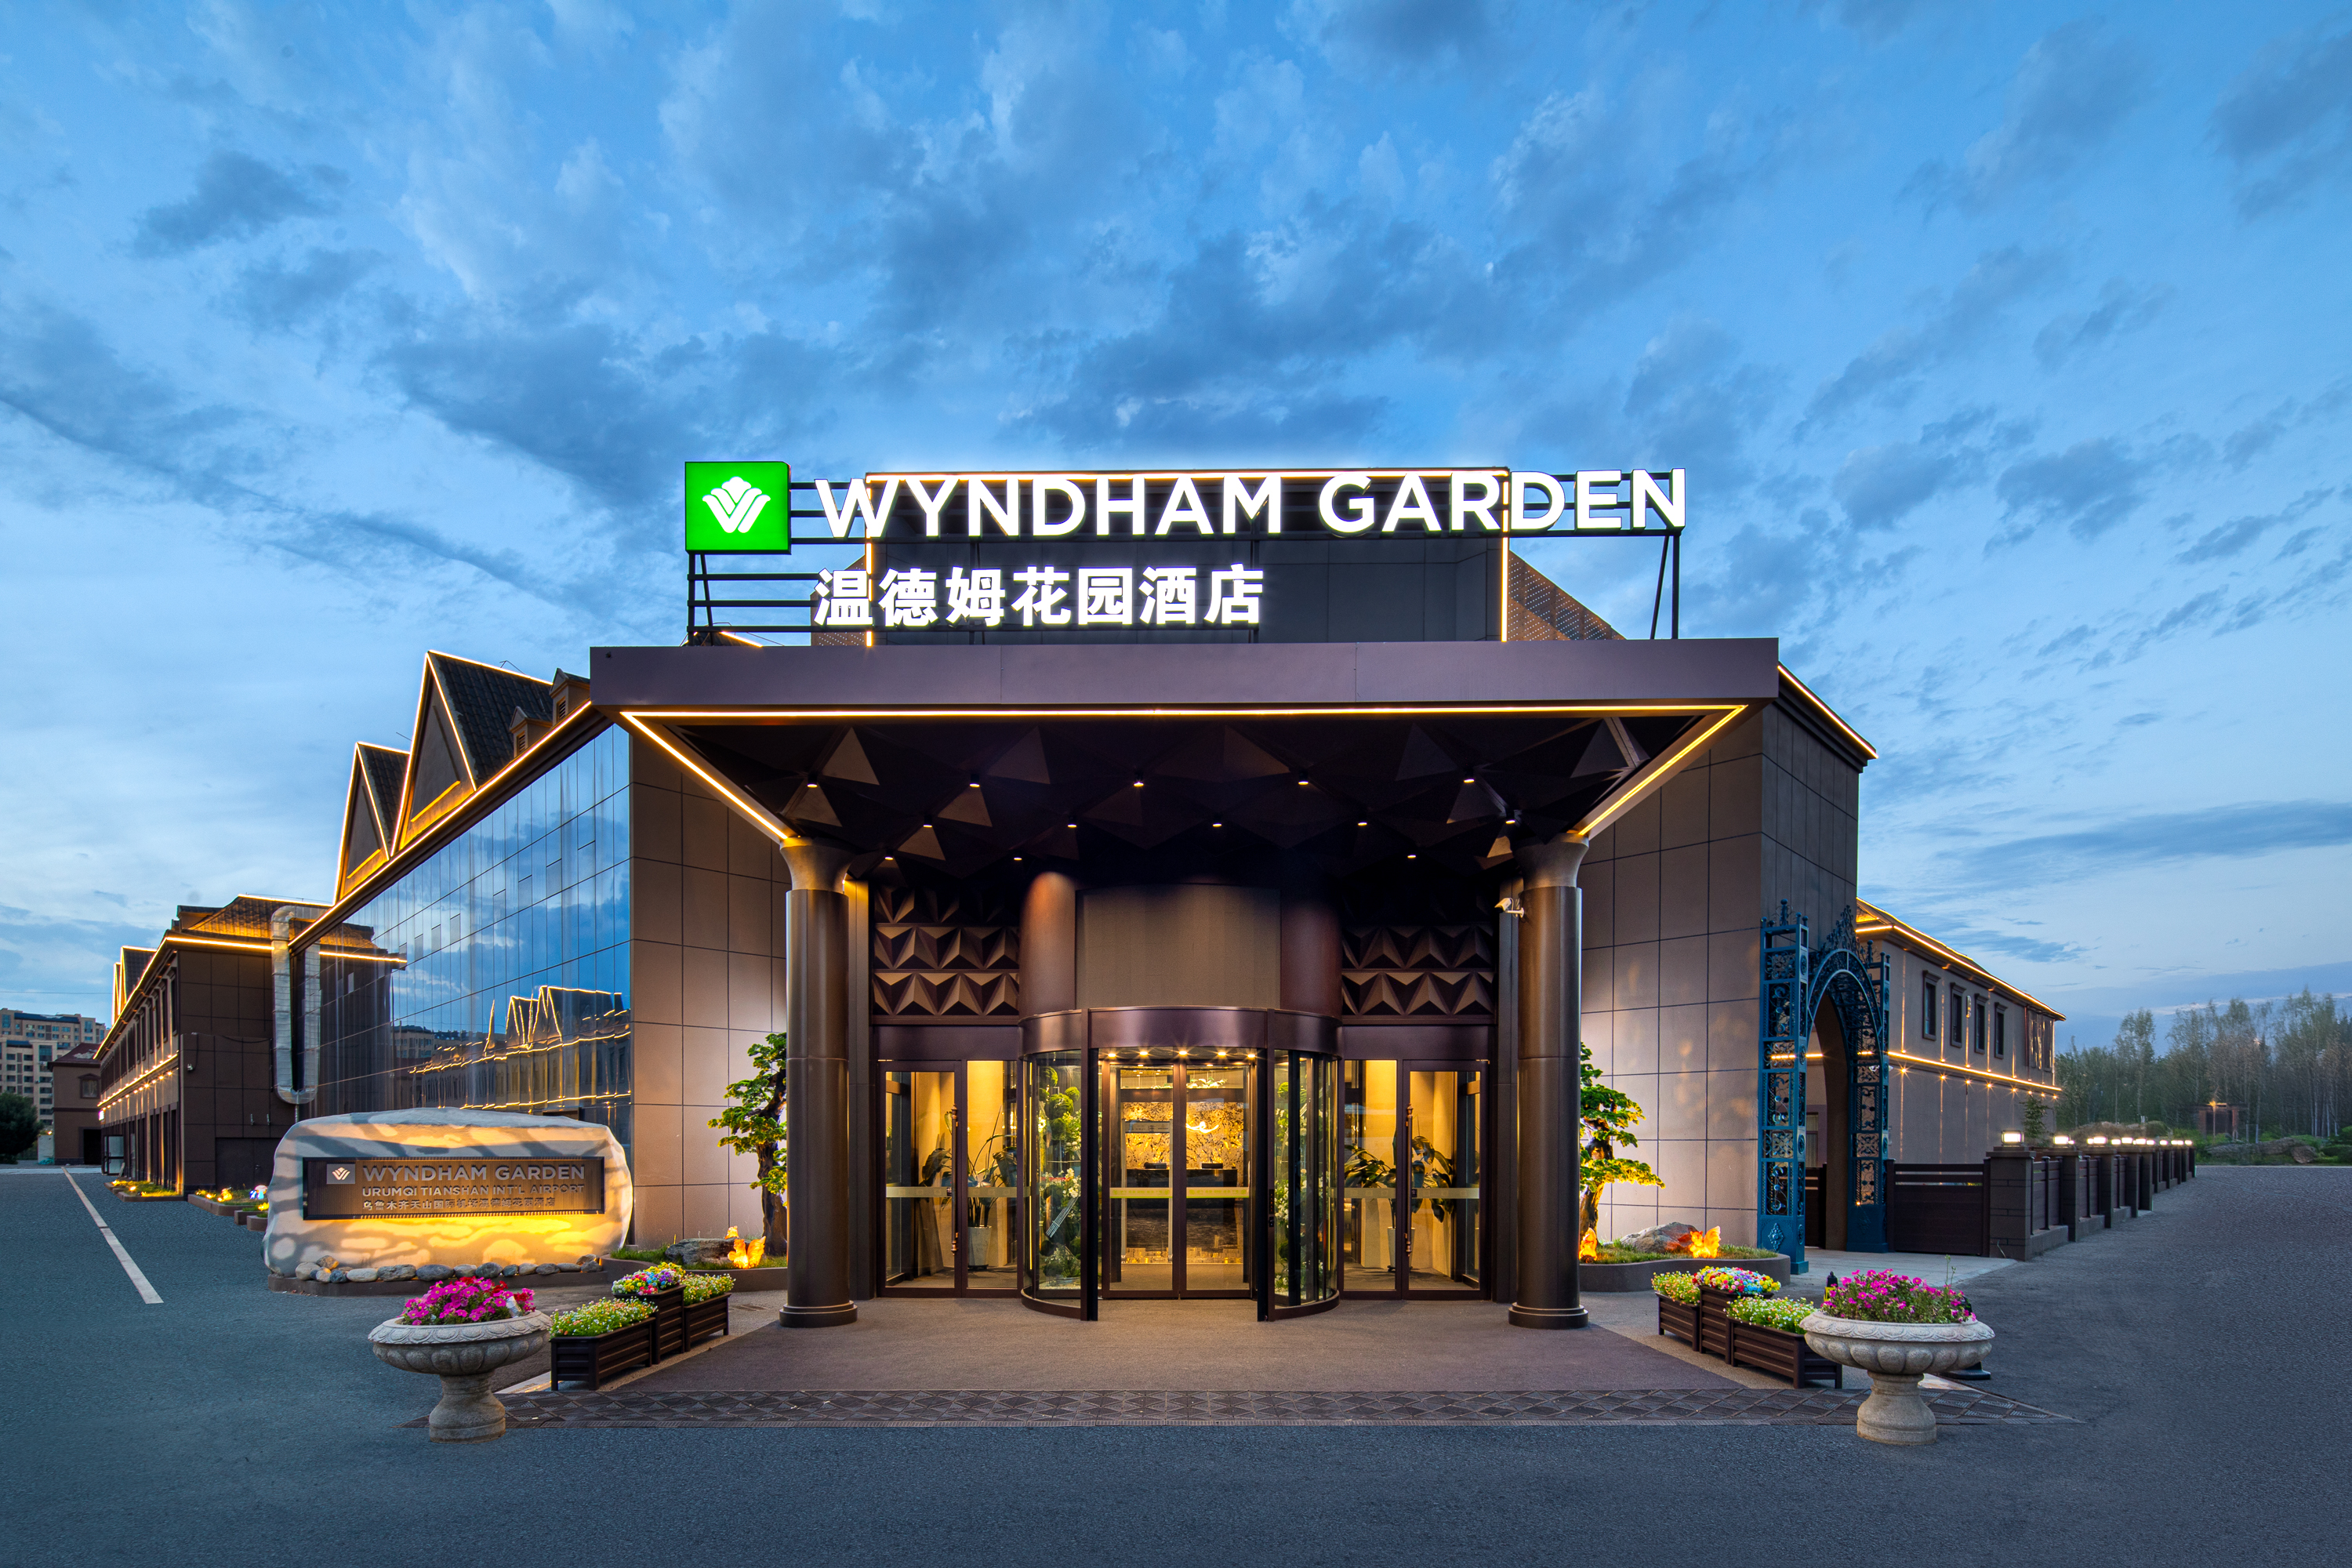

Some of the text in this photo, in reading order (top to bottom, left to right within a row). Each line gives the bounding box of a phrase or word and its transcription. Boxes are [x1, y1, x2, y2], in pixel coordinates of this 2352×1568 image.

[814, 468, 1686, 539] WYNDHAM GARDEN
[813, 563, 1265, 627] 温德姆花园酒店
[362, 1165, 586, 1181] WYNDHAM GARDEN
[362, 1185, 585, 1196] URUMQI TIANSHAN INT'L AIRPORT
